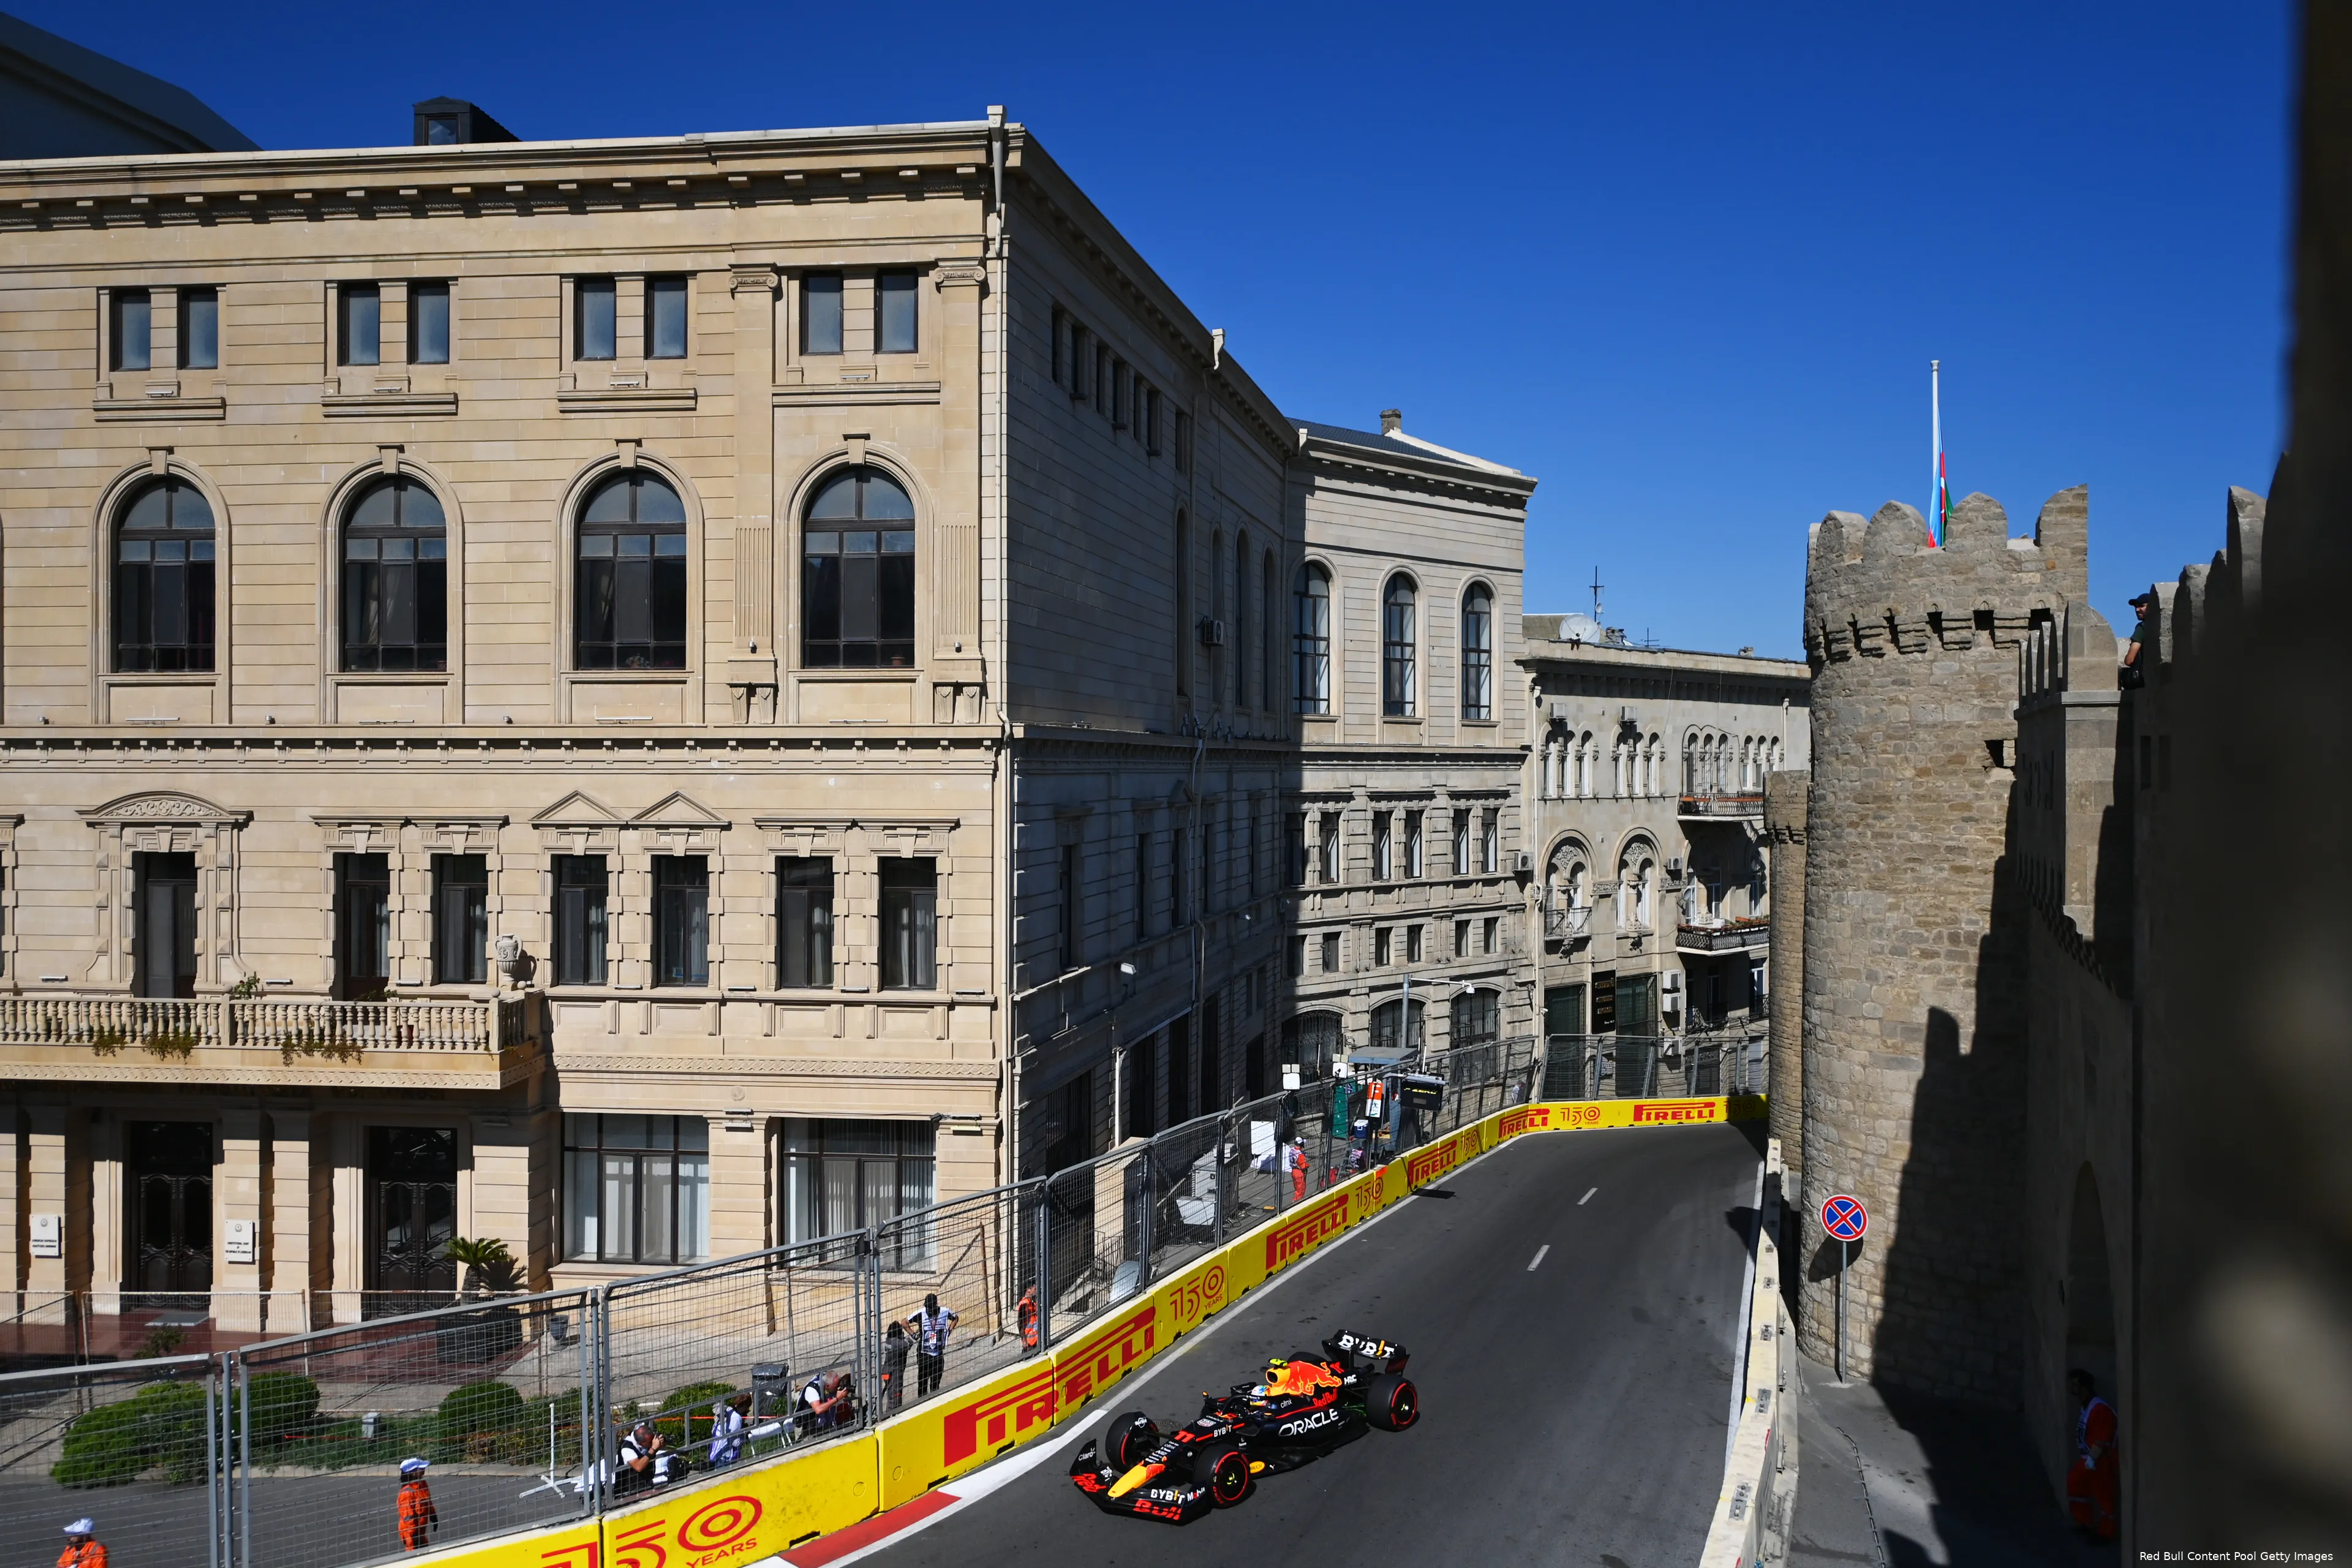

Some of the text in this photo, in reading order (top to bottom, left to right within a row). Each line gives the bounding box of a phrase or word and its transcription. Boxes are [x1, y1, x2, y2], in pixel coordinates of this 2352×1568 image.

[1560, 1107, 1600, 1126] 150
[1633, 1102, 1716, 1122] PIRELLI
[1498, 1108, 1550, 1139] PIRELLI
[1408, 1139, 1457, 1187] PIRELLI
[1355, 1176, 1384, 1212] 150
[1265, 1193, 1349, 1271] PIRELLI
[1169, 1265, 1224, 1323] 150
[1204, 1294, 1223, 1311] YEARS
[944, 1306, 1156, 1468] PIRELLI
[1313, 1388, 1338, 1407] Red Bull
[1213, 1424, 1232, 1438] BYBIT
[1278, 1409, 1339, 1437] ORACLE
[1174, 1430, 1195, 1443] 11
[1078, 1450, 1095, 1461] Claro
[1150, 1488, 1185, 1504] BYBIT
[1133, 1499, 1182, 1521] Bull
[686, 1537, 758, 1568] YEARS
